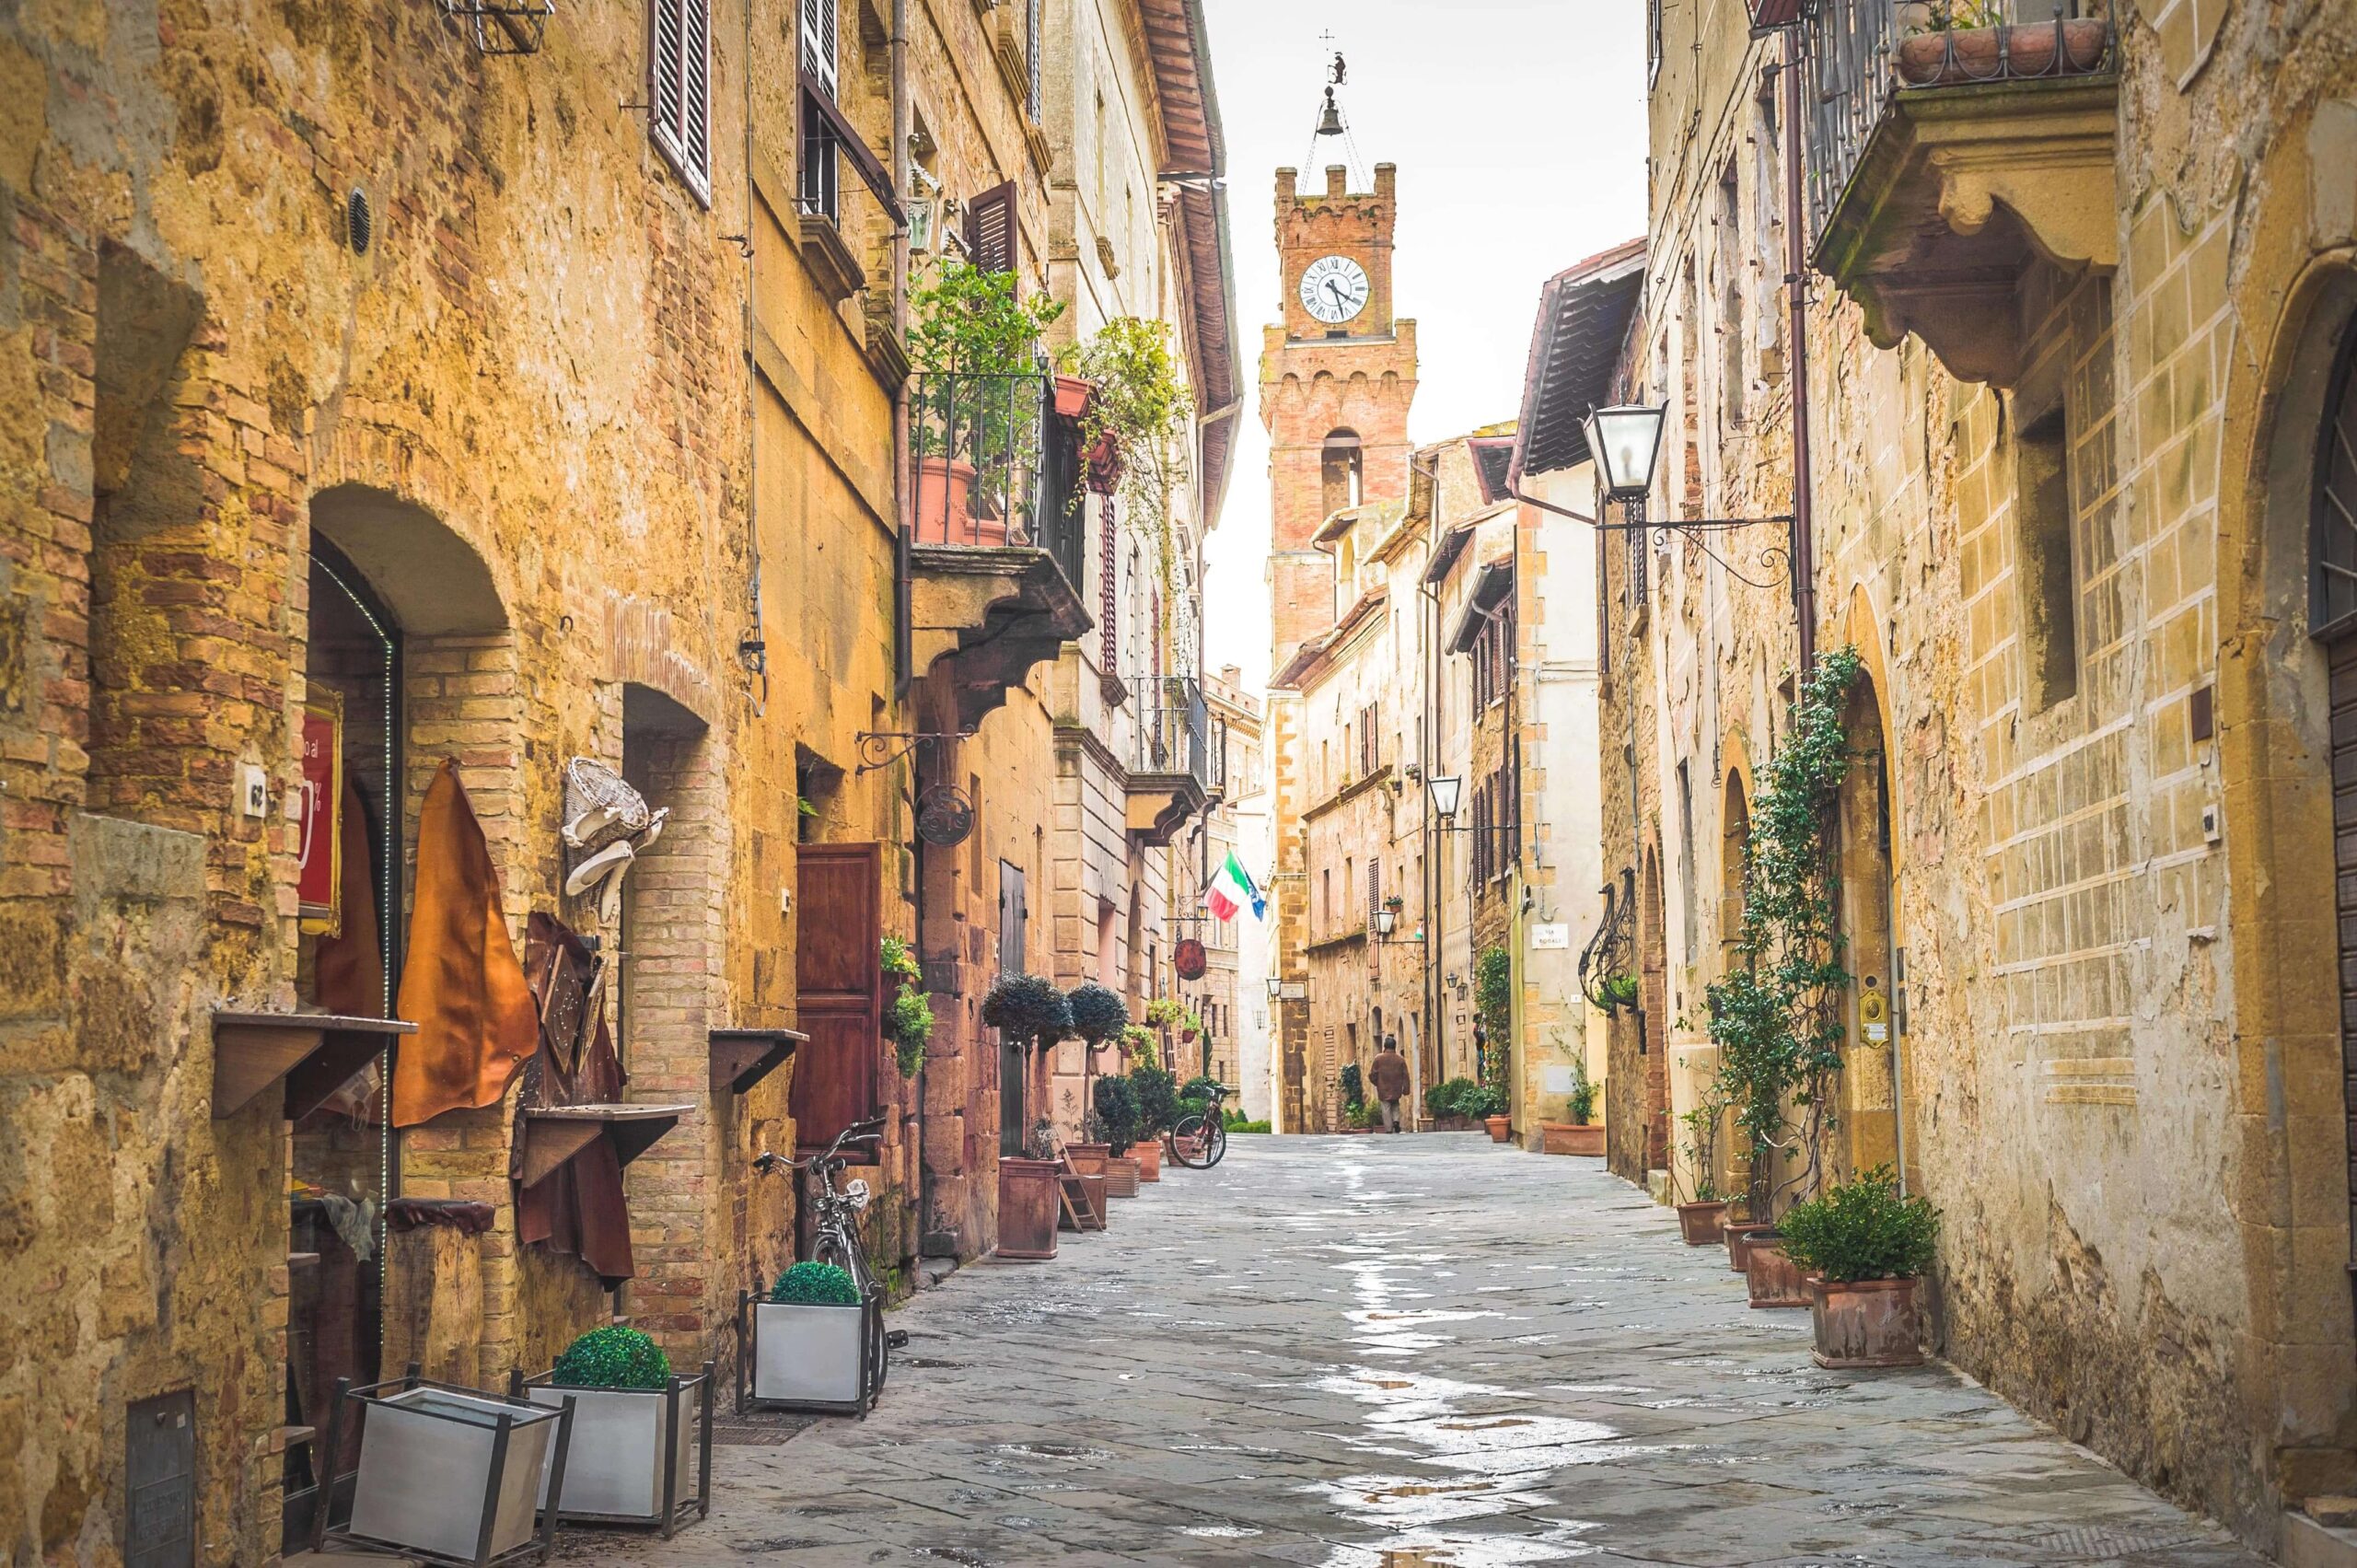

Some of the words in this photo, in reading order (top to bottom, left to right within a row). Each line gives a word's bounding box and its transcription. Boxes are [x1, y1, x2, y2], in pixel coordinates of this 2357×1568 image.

[1330, 259, 1339, 269] XII
[1344, 261, 1350, 272] I
[310, 738, 319, 759] al
